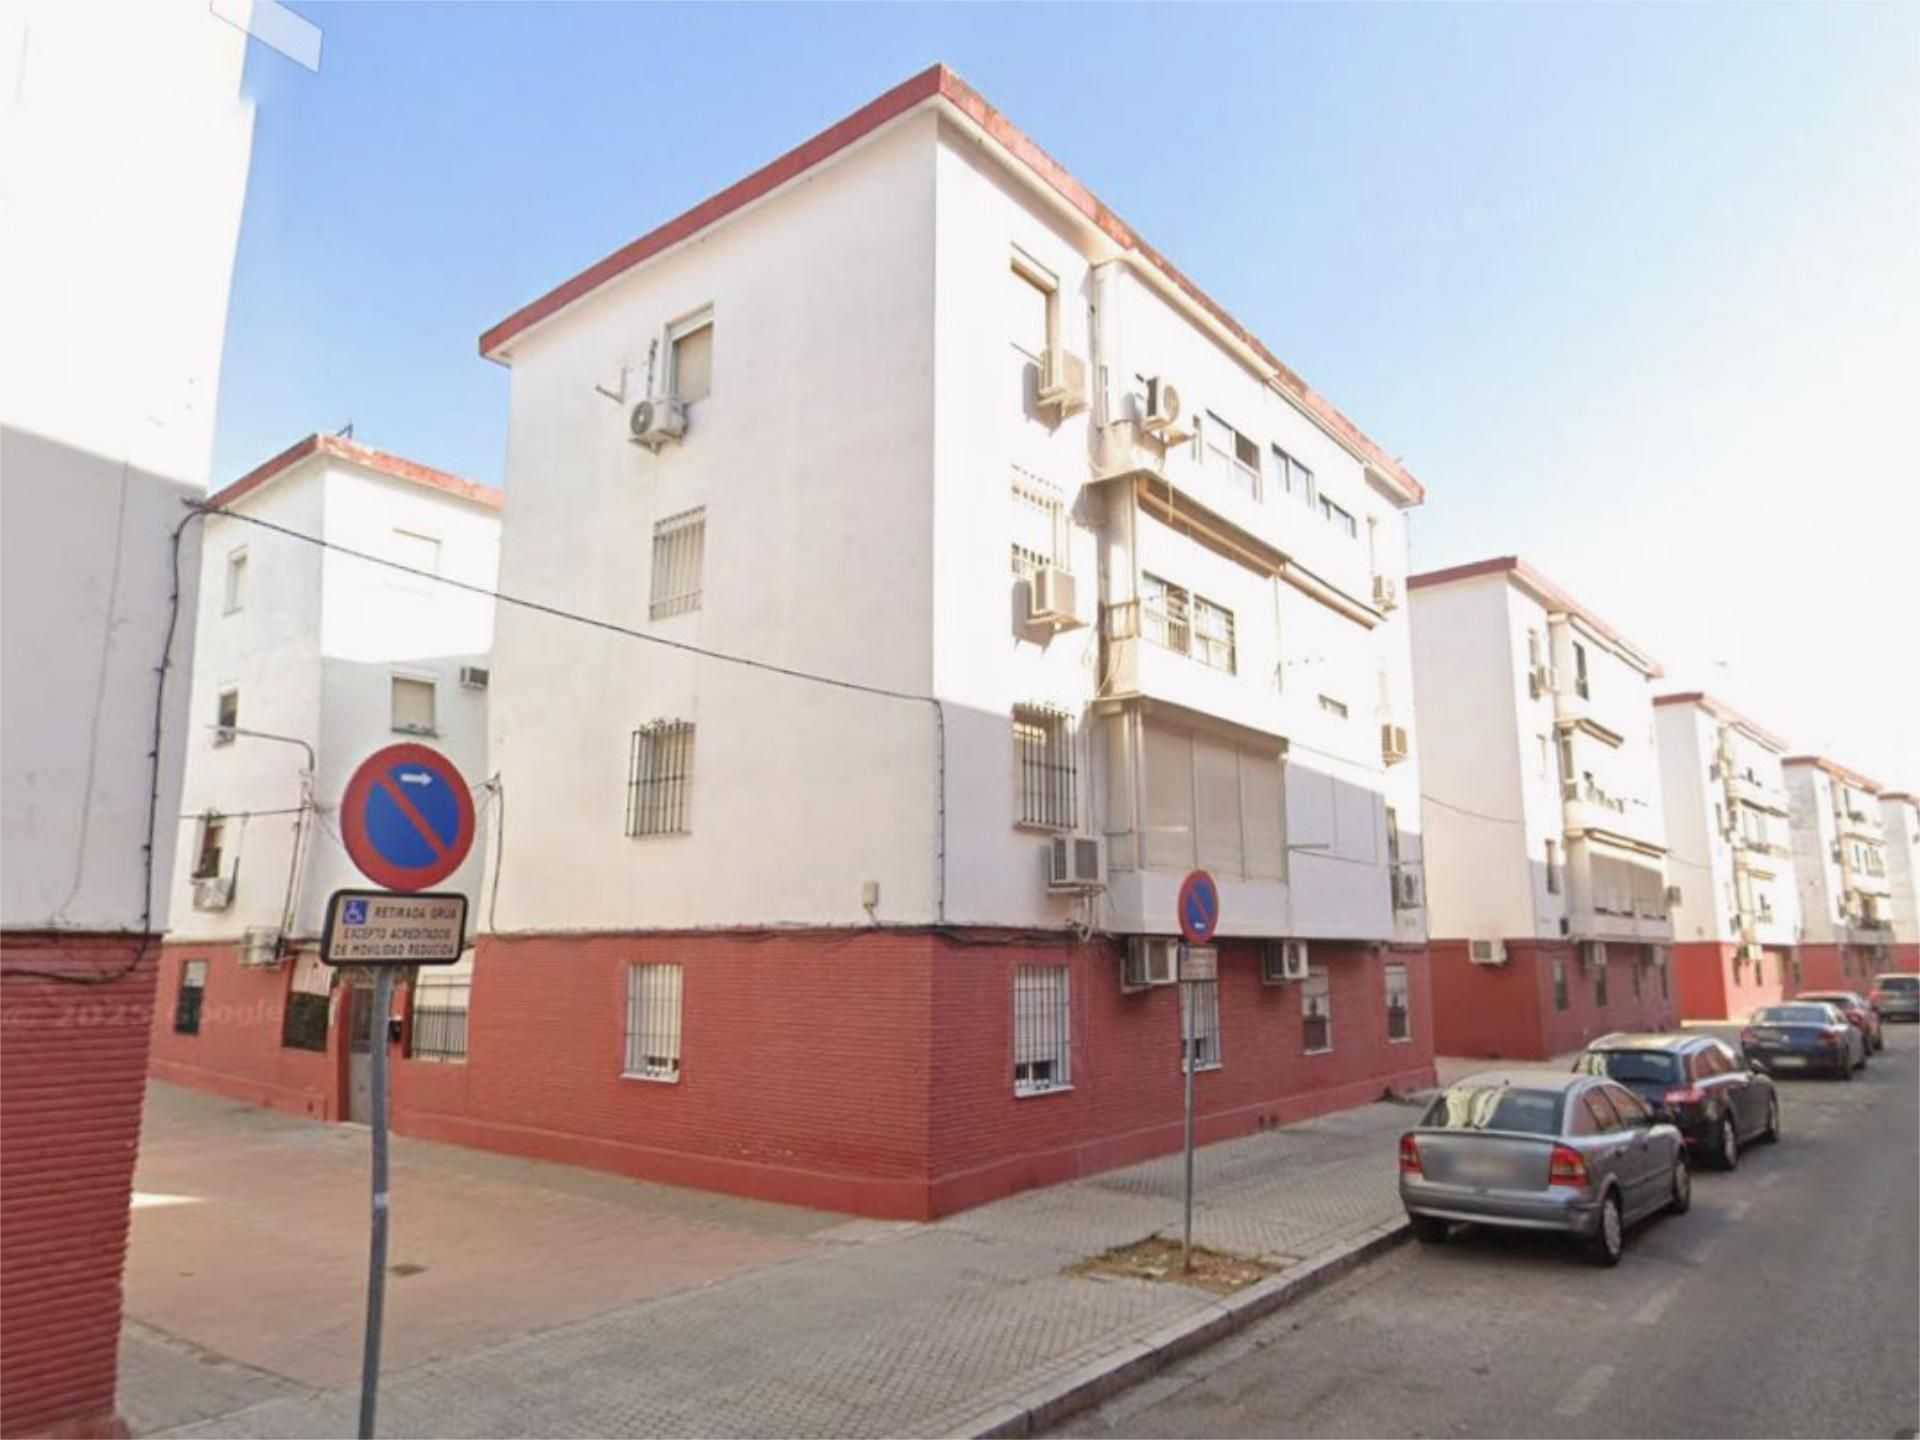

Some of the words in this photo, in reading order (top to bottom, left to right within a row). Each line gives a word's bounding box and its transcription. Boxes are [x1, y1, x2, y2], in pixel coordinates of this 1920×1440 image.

[374, 906, 425, 919] RETIRADA
[343, 927, 386, 940] EXCEPTO
[390, 926, 450, 940] ACREDITADOS
[334, 943, 347, 956] DE
[351, 943, 404, 956] MOVILIDAD
[409, 942, 454, 956] REDUCIDA
